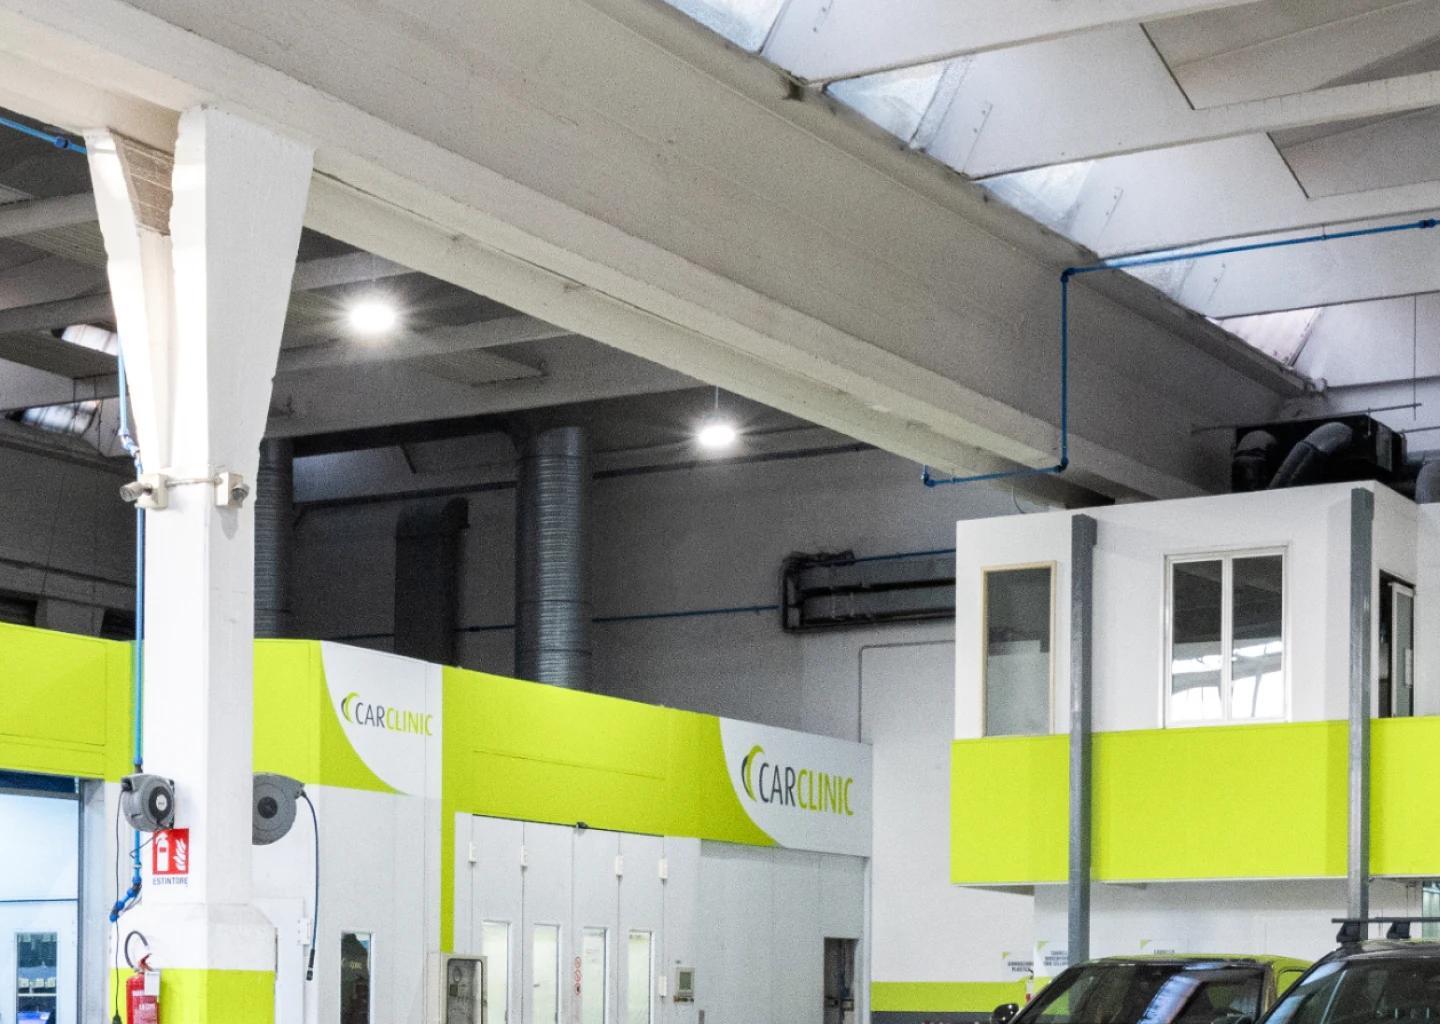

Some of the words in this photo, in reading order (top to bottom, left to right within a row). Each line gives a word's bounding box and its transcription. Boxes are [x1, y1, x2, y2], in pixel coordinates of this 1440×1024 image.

[355, 702, 433, 736] CARCLINIC
[759, 762, 853, 816] CARCLINIC
[152, 876, 188, 885] ESTINTORE
